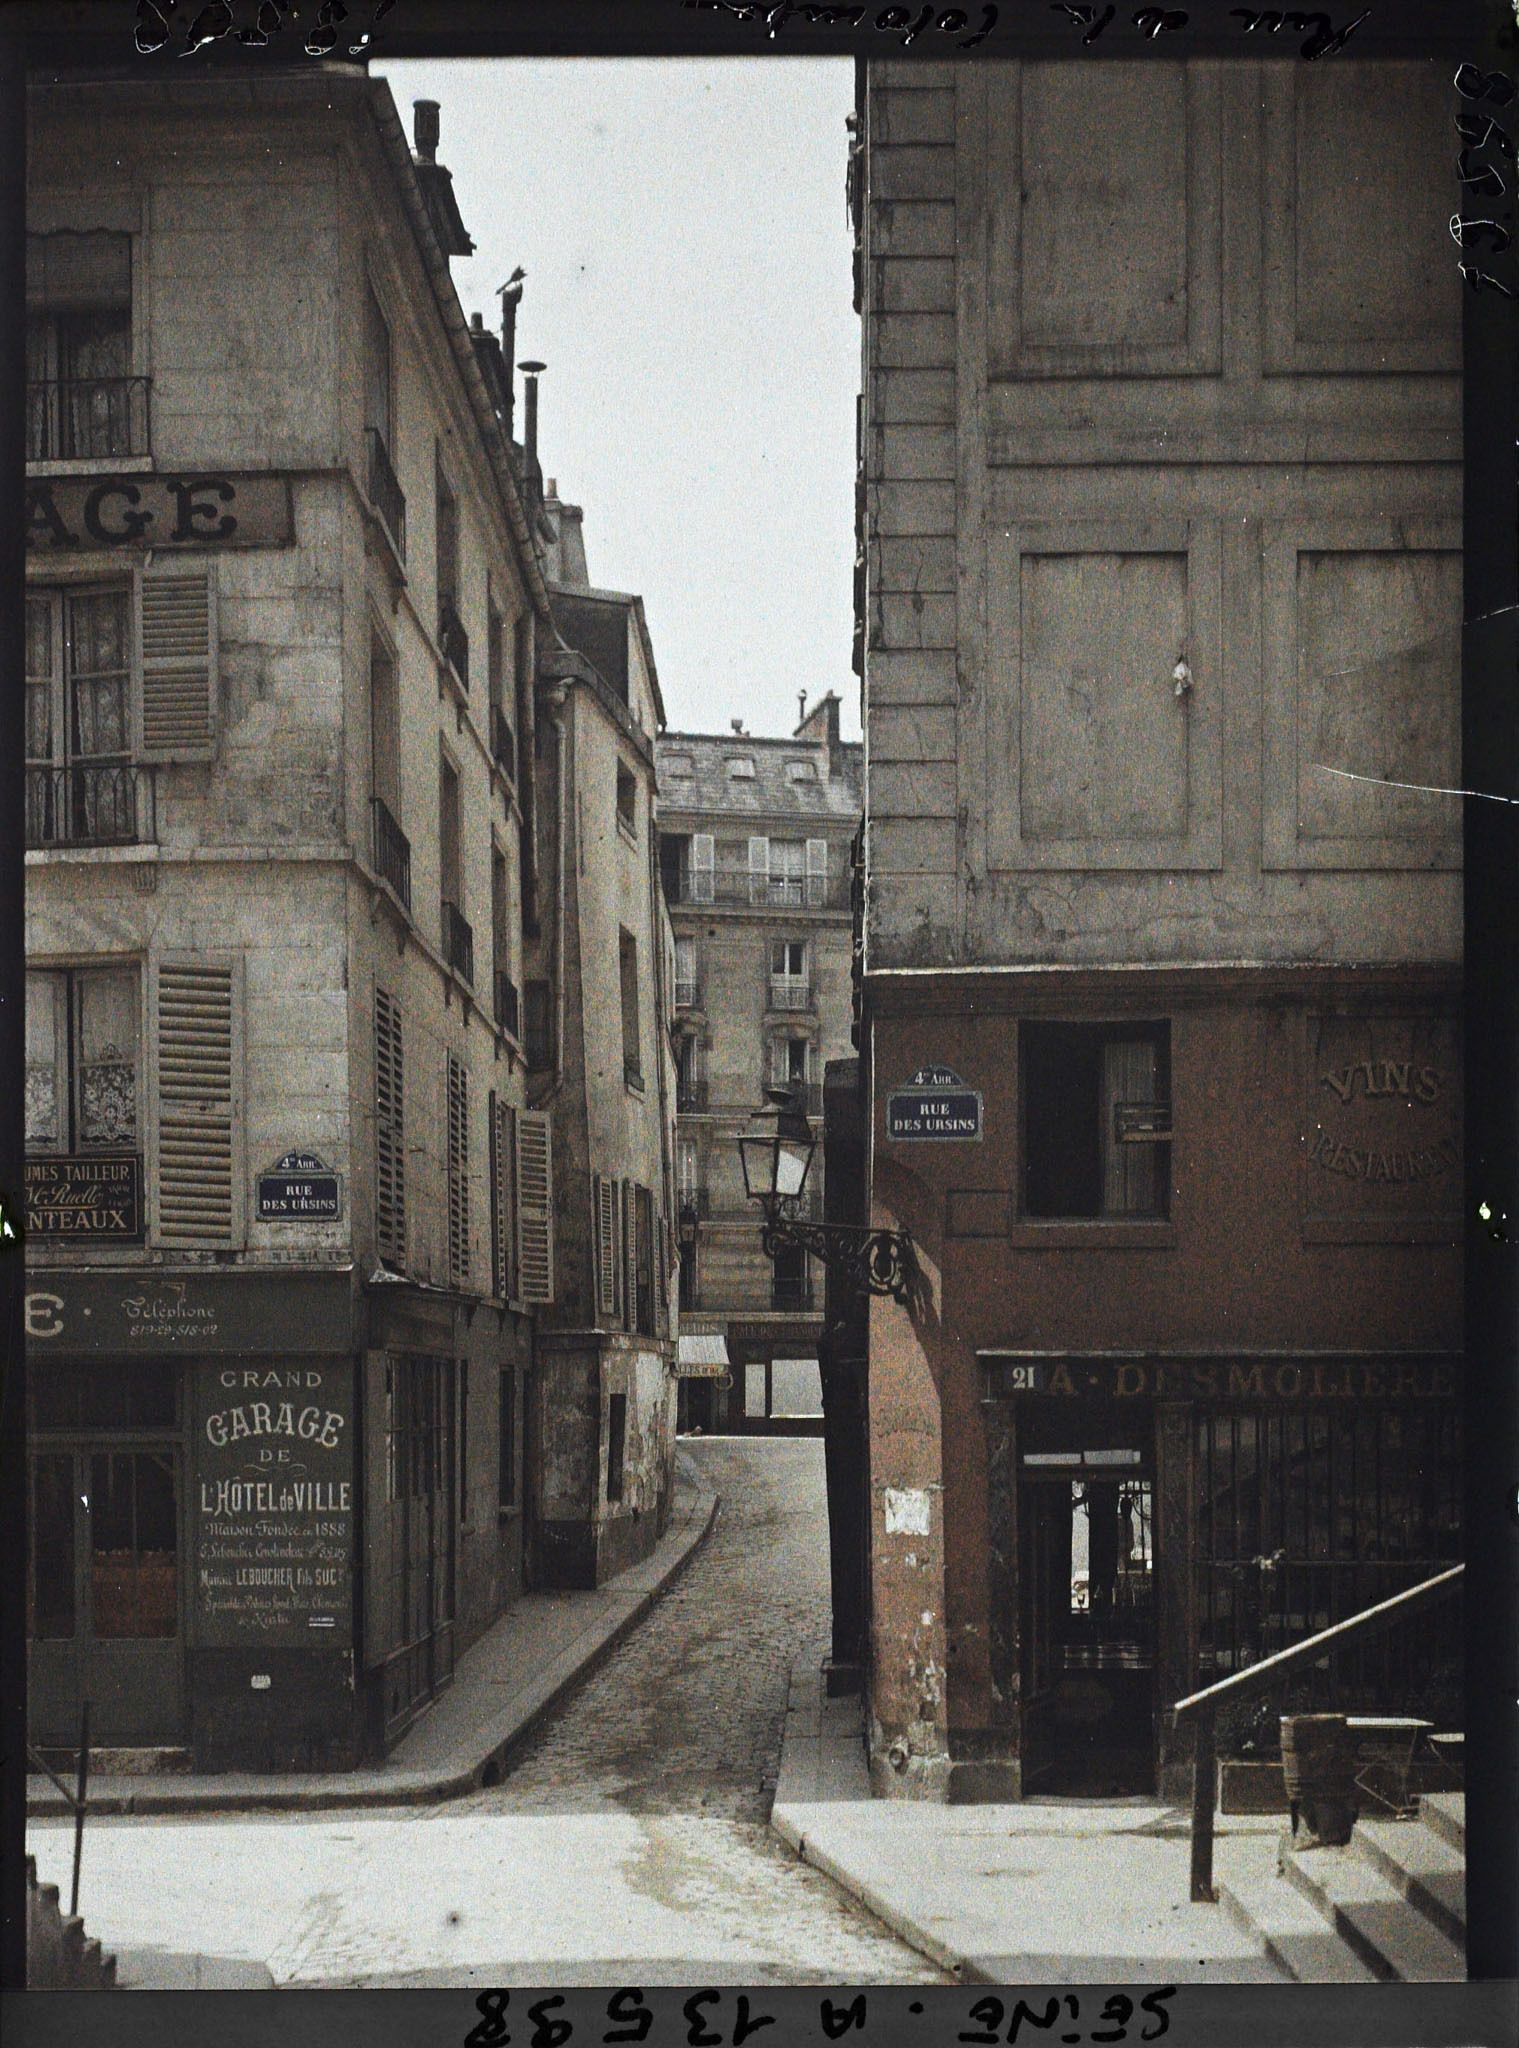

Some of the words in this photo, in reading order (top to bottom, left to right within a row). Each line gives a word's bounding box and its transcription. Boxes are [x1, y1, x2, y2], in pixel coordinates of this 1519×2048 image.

[1320, 1060, 1440, 1102] VINS
[920, 1103, 950, 1115] RUE
[894, 1119, 922, 1131] DES
[926, 1119, 976, 1131] URSINS
[286, 1185, 312, 1196] RUE
[262, 1200, 288, 1210] DES
[292, 1199, 336, 1210] URSINS
[220, 1370, 323, 1388] GRAND
[1012, 1366, 1035, 1389] 21
[1052, 1364, 1077, 1396] A
[206, 1402, 345, 1448] GARAGE
[260, 1449, 290, 1463] DE
[201, 1476, 279, 1517] L'HÔTEL
[279, 1488, 295, 1511] de
[293, 1482, 351, 1512] VILLE
[205, 1522, 253, 1537] Maison
[315, 1522, 347, 1537] 1888
[236, 1567, 296, 1593] LEBOUCHER
